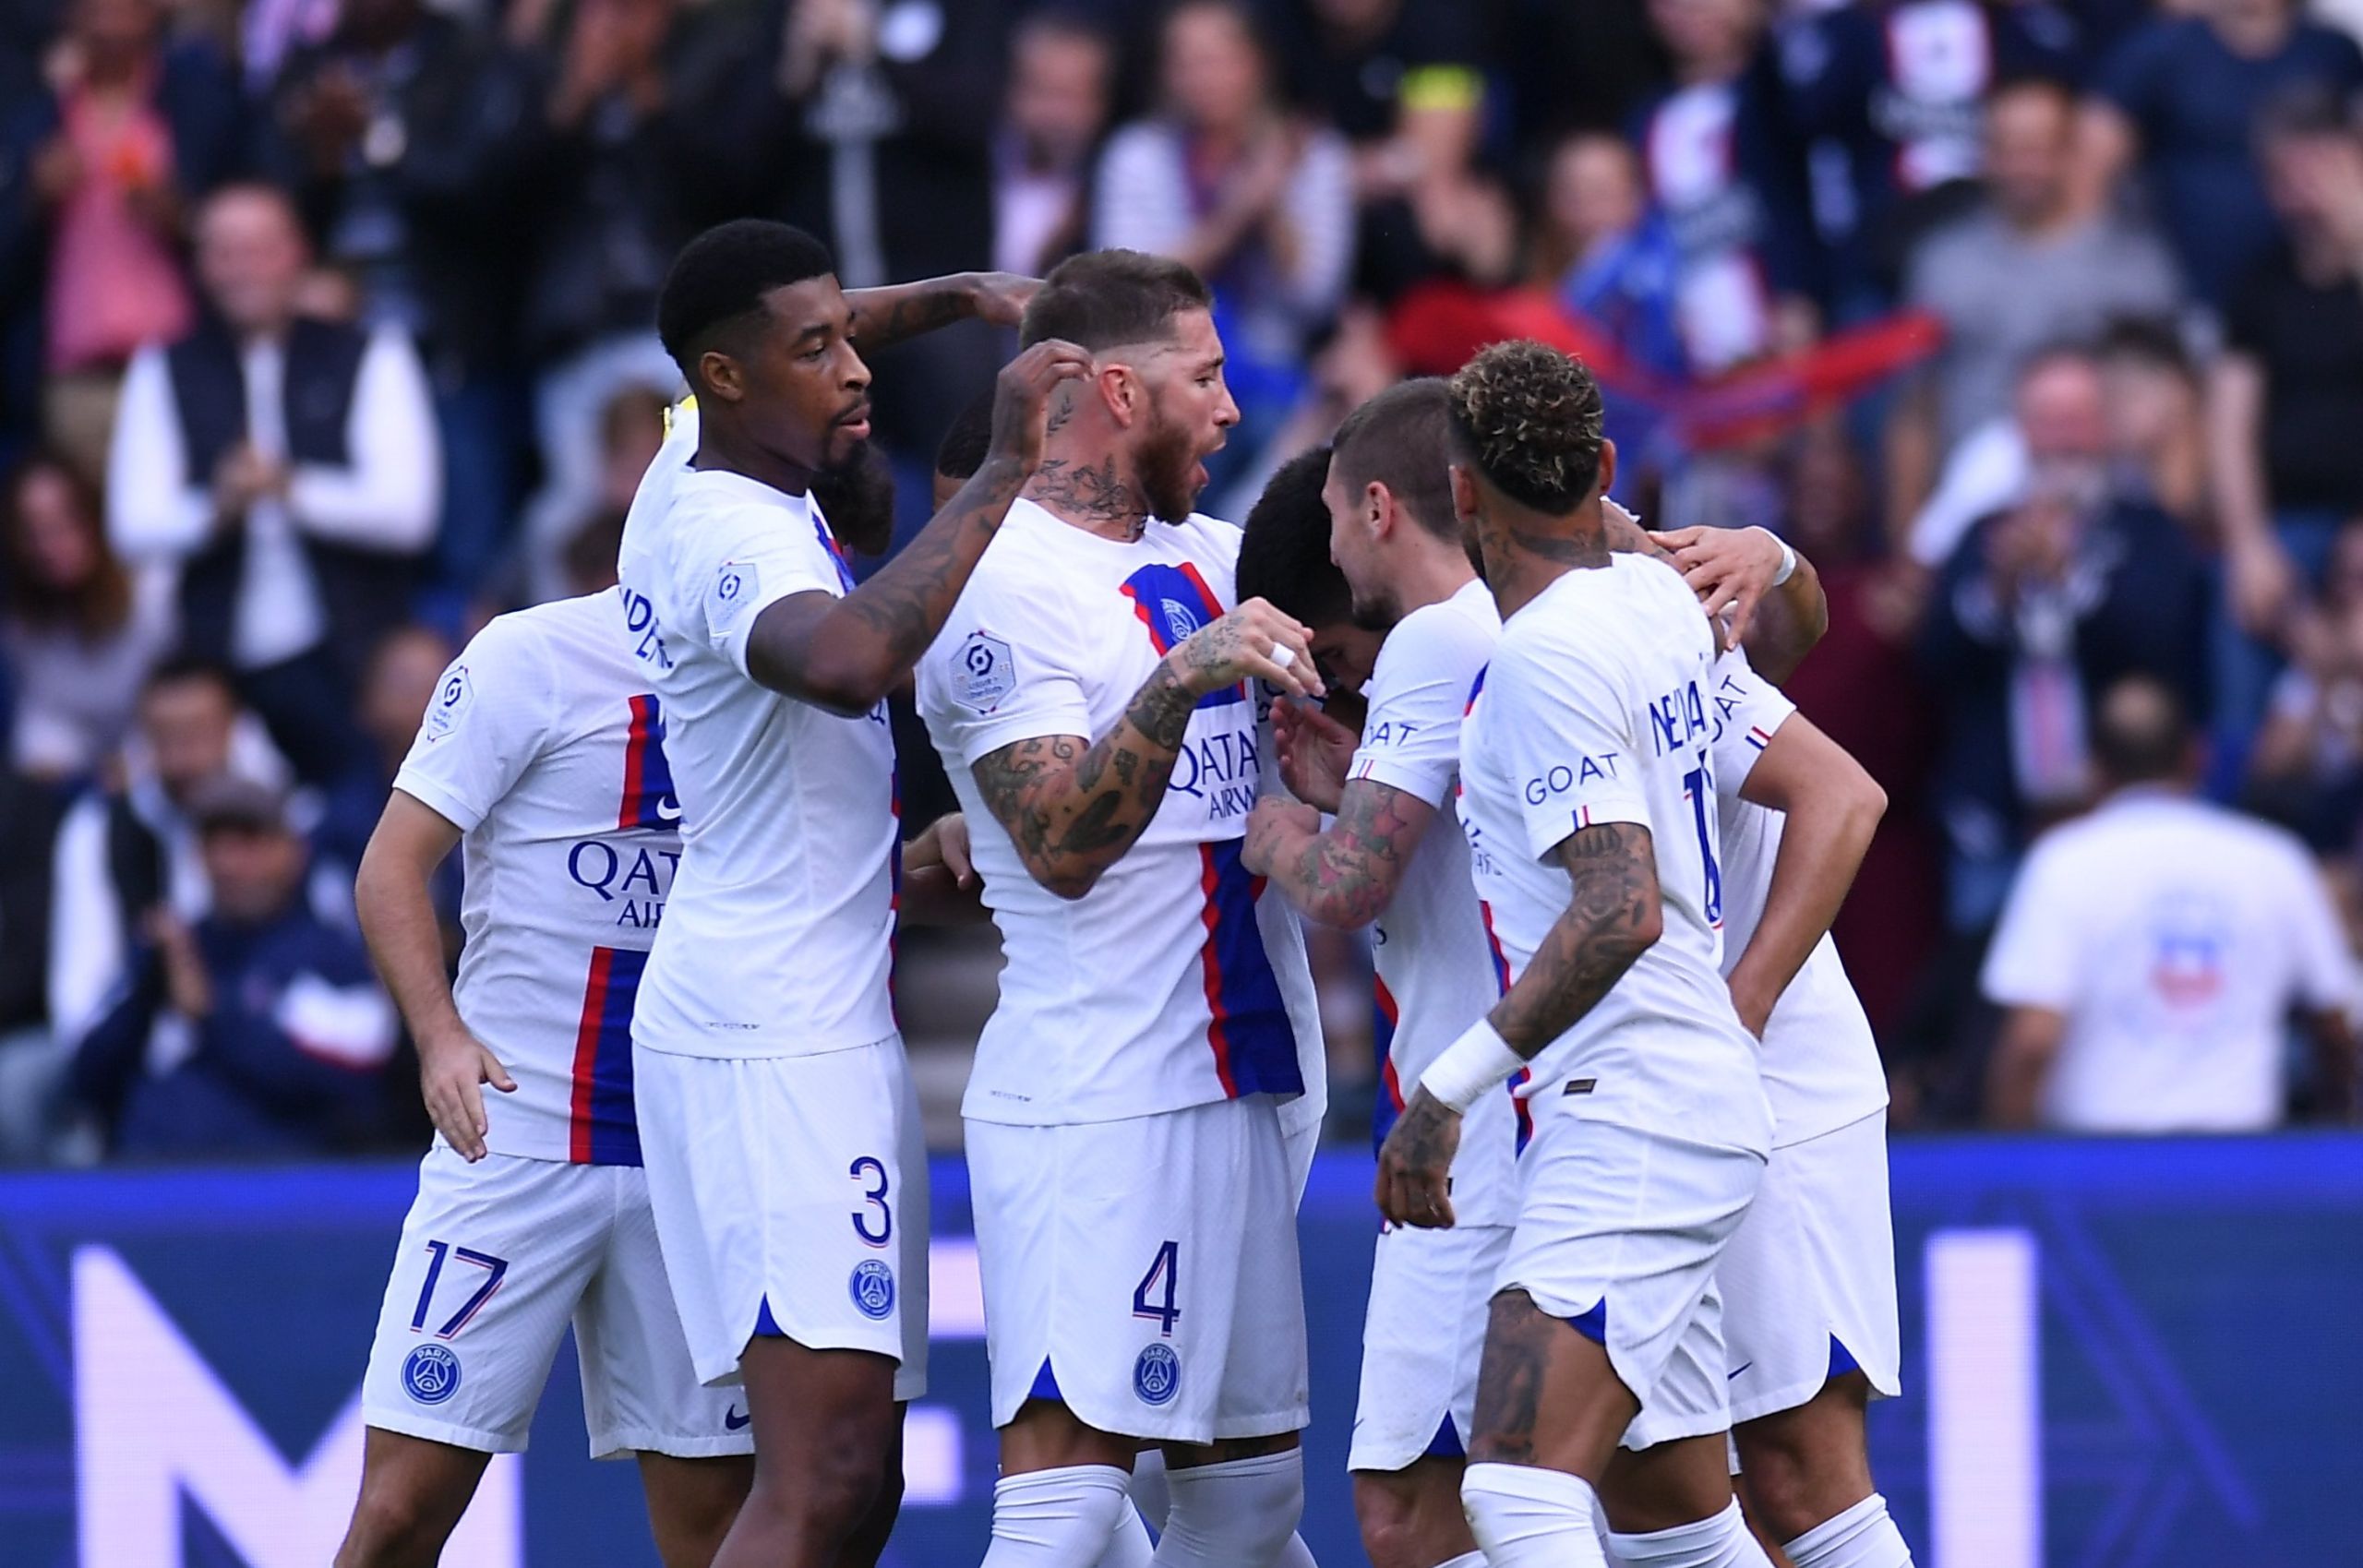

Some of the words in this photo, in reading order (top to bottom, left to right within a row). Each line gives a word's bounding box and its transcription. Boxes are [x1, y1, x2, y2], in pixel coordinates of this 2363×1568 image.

[1525, 752, 1618, 806] GOAT
[849, 1155, 892, 1249] 3
[410, 1239, 510, 1340] 17
[1133, 1239, 1182, 1338] 4
[415, 1347, 452, 1368] PARIS
